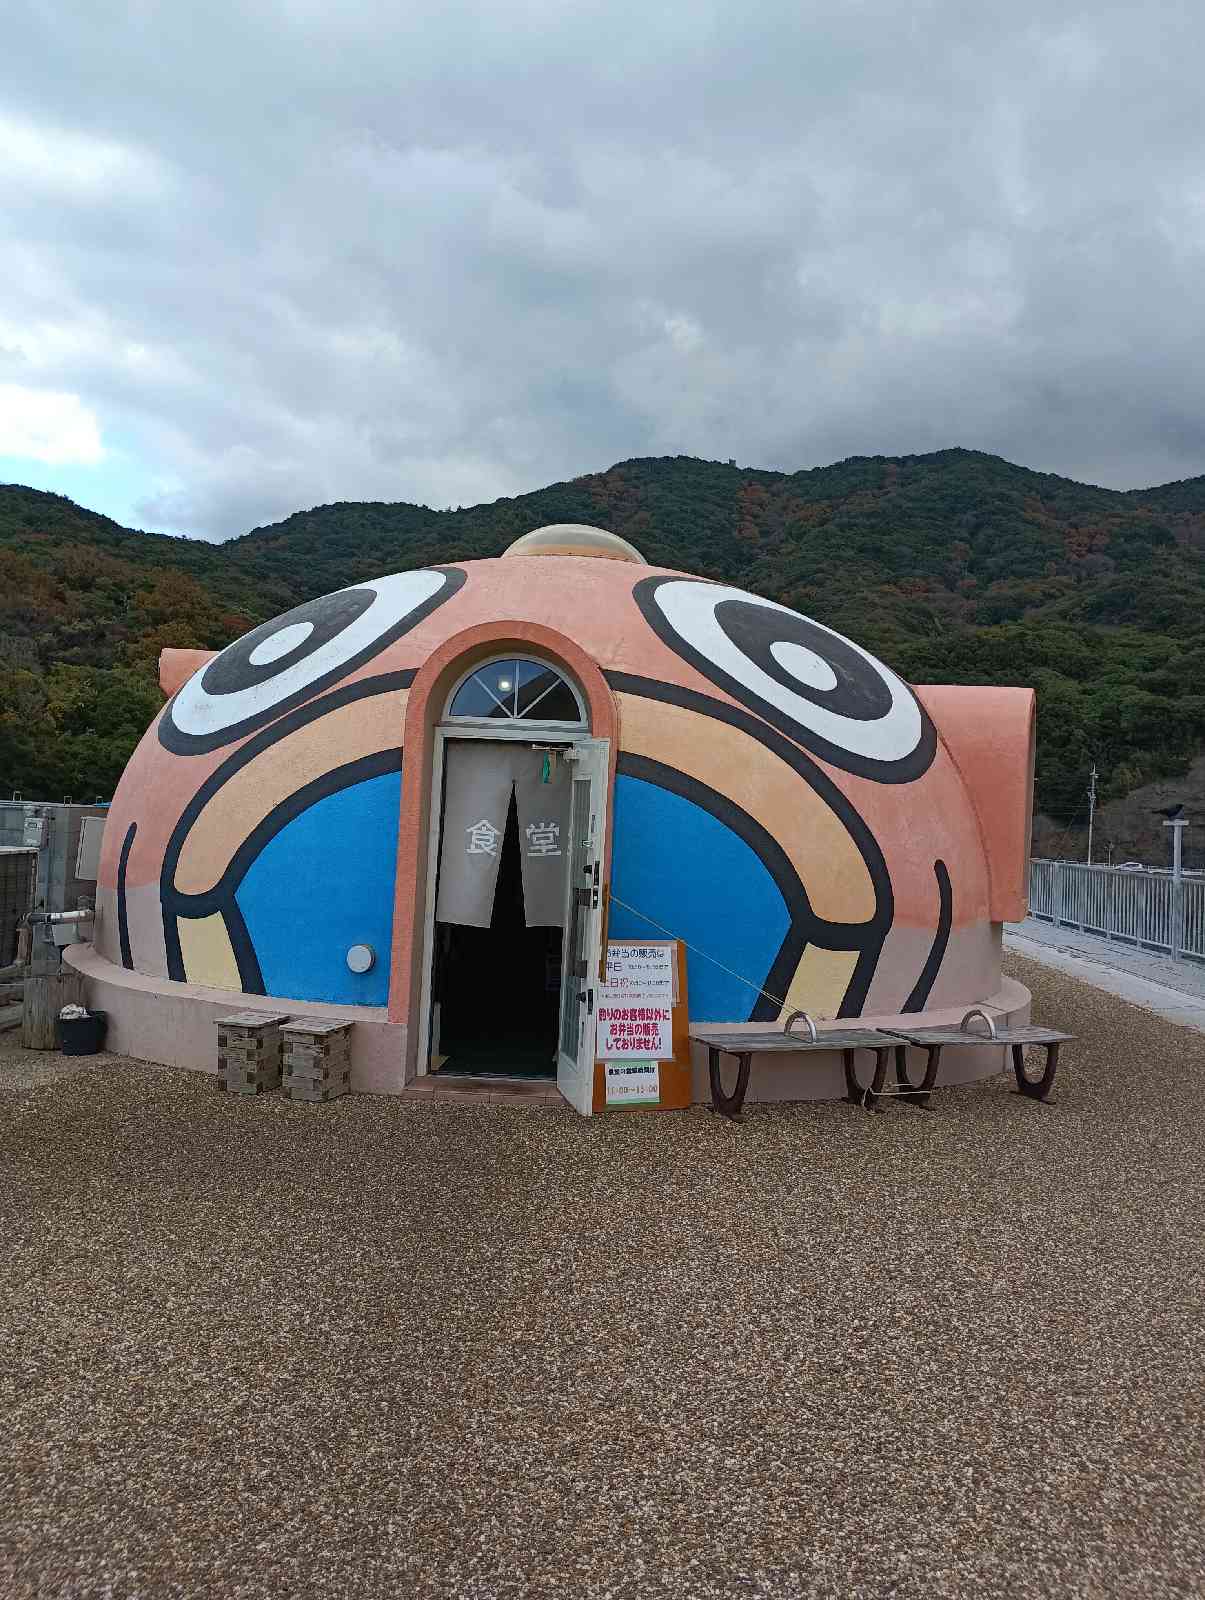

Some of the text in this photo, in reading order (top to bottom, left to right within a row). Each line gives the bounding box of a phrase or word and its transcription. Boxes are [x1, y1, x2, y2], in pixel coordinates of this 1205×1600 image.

[464, 819, 562, 857] 食堂
[599, 1008, 670, 1021] 釣りのお客様以外に
[609, 1022, 660, 1036] お弁当の販売
